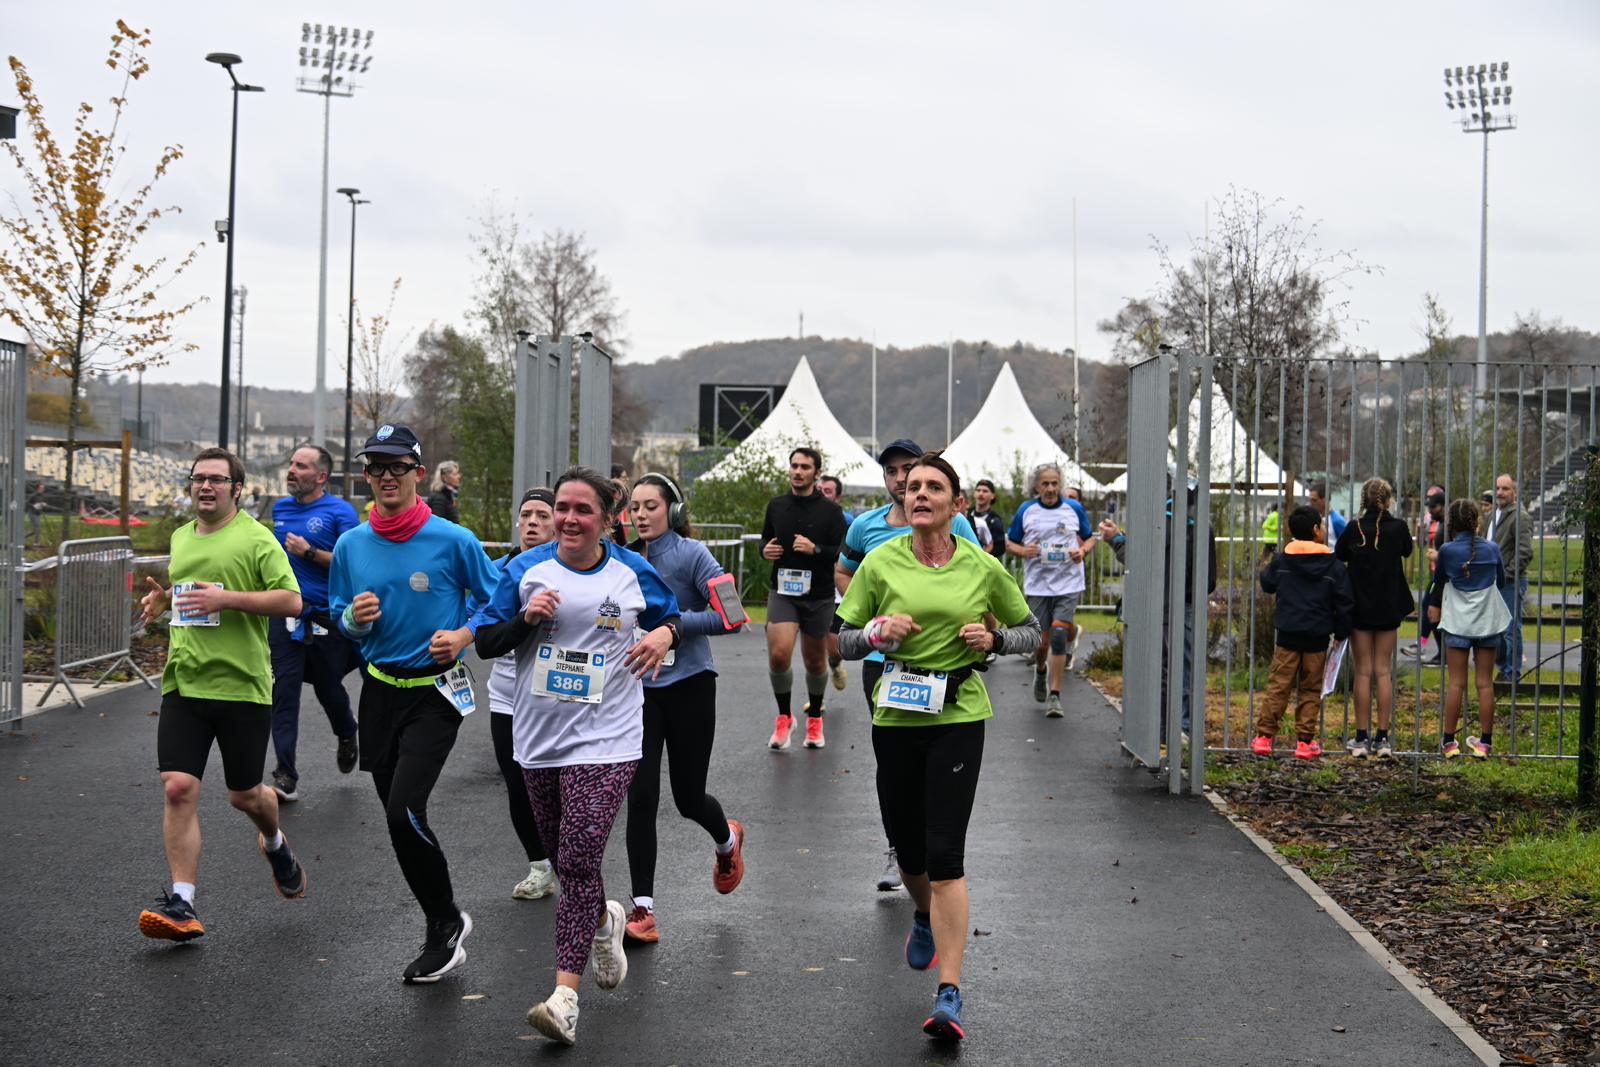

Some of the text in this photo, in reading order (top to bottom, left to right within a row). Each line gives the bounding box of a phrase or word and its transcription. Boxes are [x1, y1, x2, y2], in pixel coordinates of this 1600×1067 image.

[784, 582, 803, 591] 2101
[555, 662, 585, 673] STEPHANIE
[552, 675, 584, 692] 386
[900, 674, 924, 683] CHANTAL
[889, 685, 929, 702] 2201
